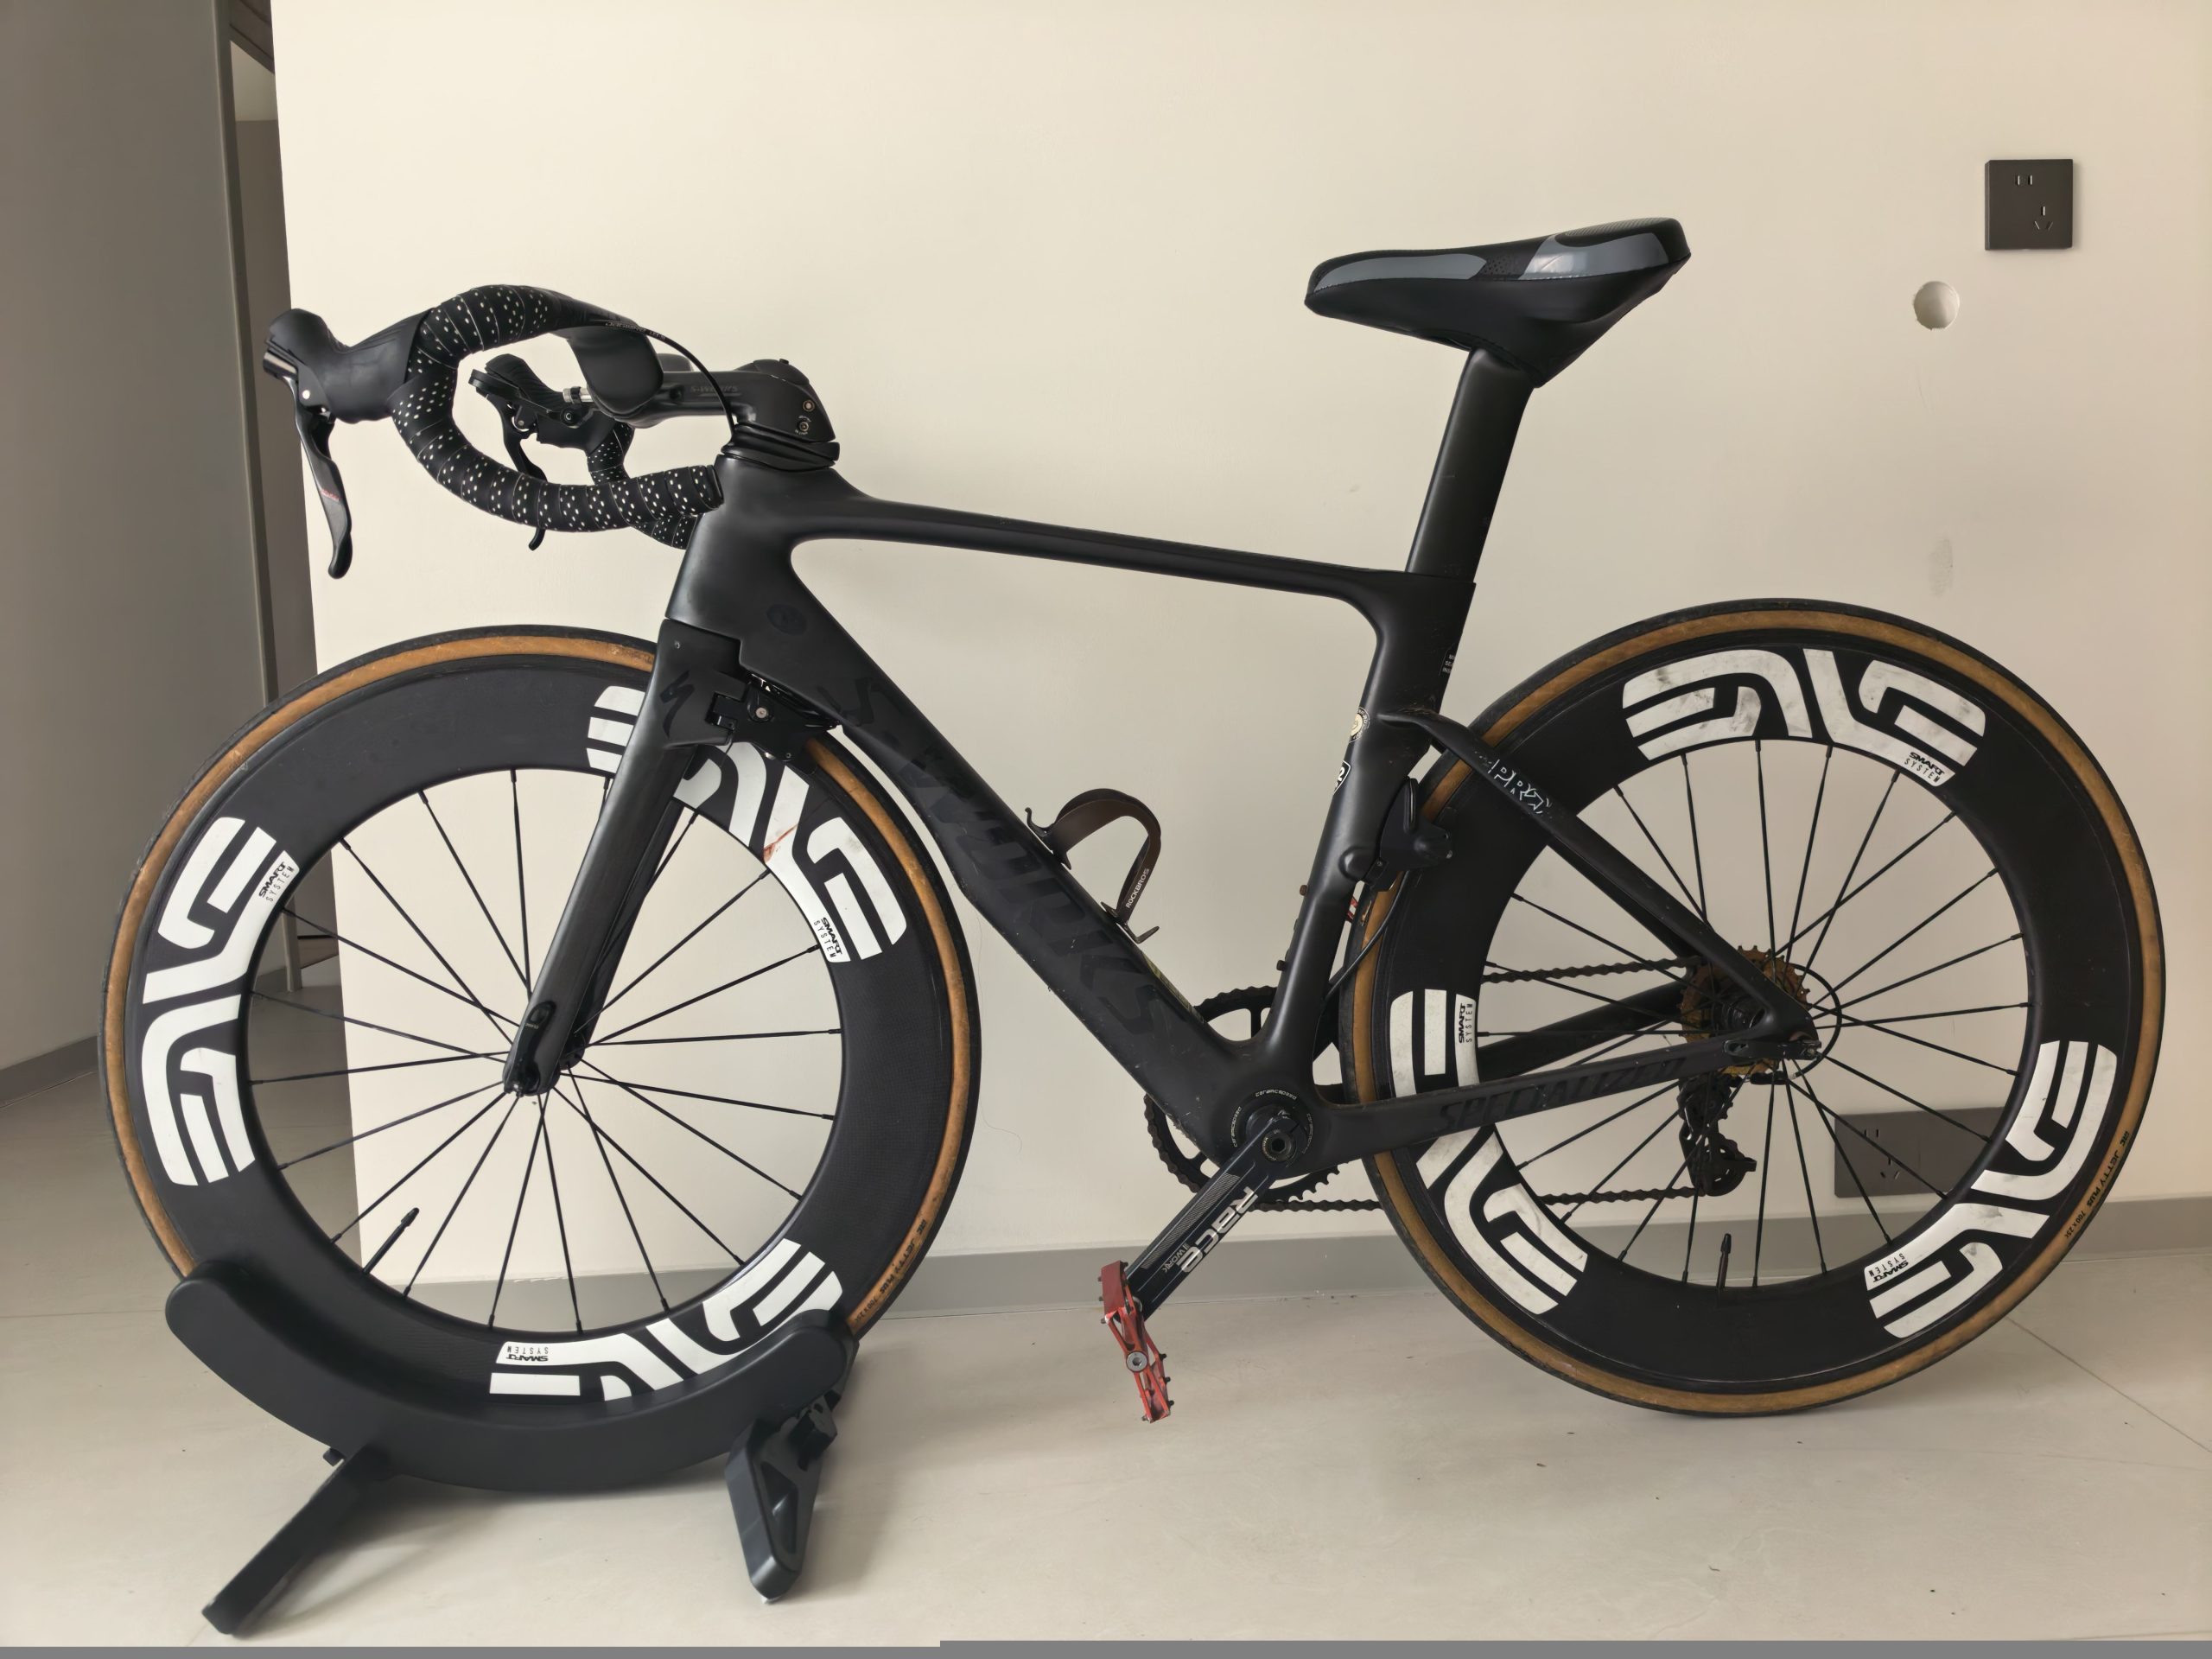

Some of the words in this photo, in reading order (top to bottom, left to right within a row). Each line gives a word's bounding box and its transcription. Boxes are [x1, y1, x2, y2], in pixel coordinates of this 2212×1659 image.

[1904, 759, 1940, 782] SYSTEM
[1910, 752, 1945, 775] SMART
[259, 862, 285, 897] SMART
[266, 866, 294, 901] SYSTEM
[1126, 868, 1149, 908] ROCKBROS
[814, 921, 836, 957] SYSTEM
[821, 918, 842, 954] SMART
[1458, 1003, 1466, 1044] SMART
[1435, 1057, 1688, 1131] SPECIALIZED
[2100, 1149, 2120, 1188] JETTY
[2087, 1186, 2101, 1206] PLUS
[893, 1238, 915, 1274] JETTY
[1869, 1254, 1904, 1277] SYSTEM
[1873, 1260, 1909, 1282] SMART
[880, 1274, 894, 1294] PLUS
